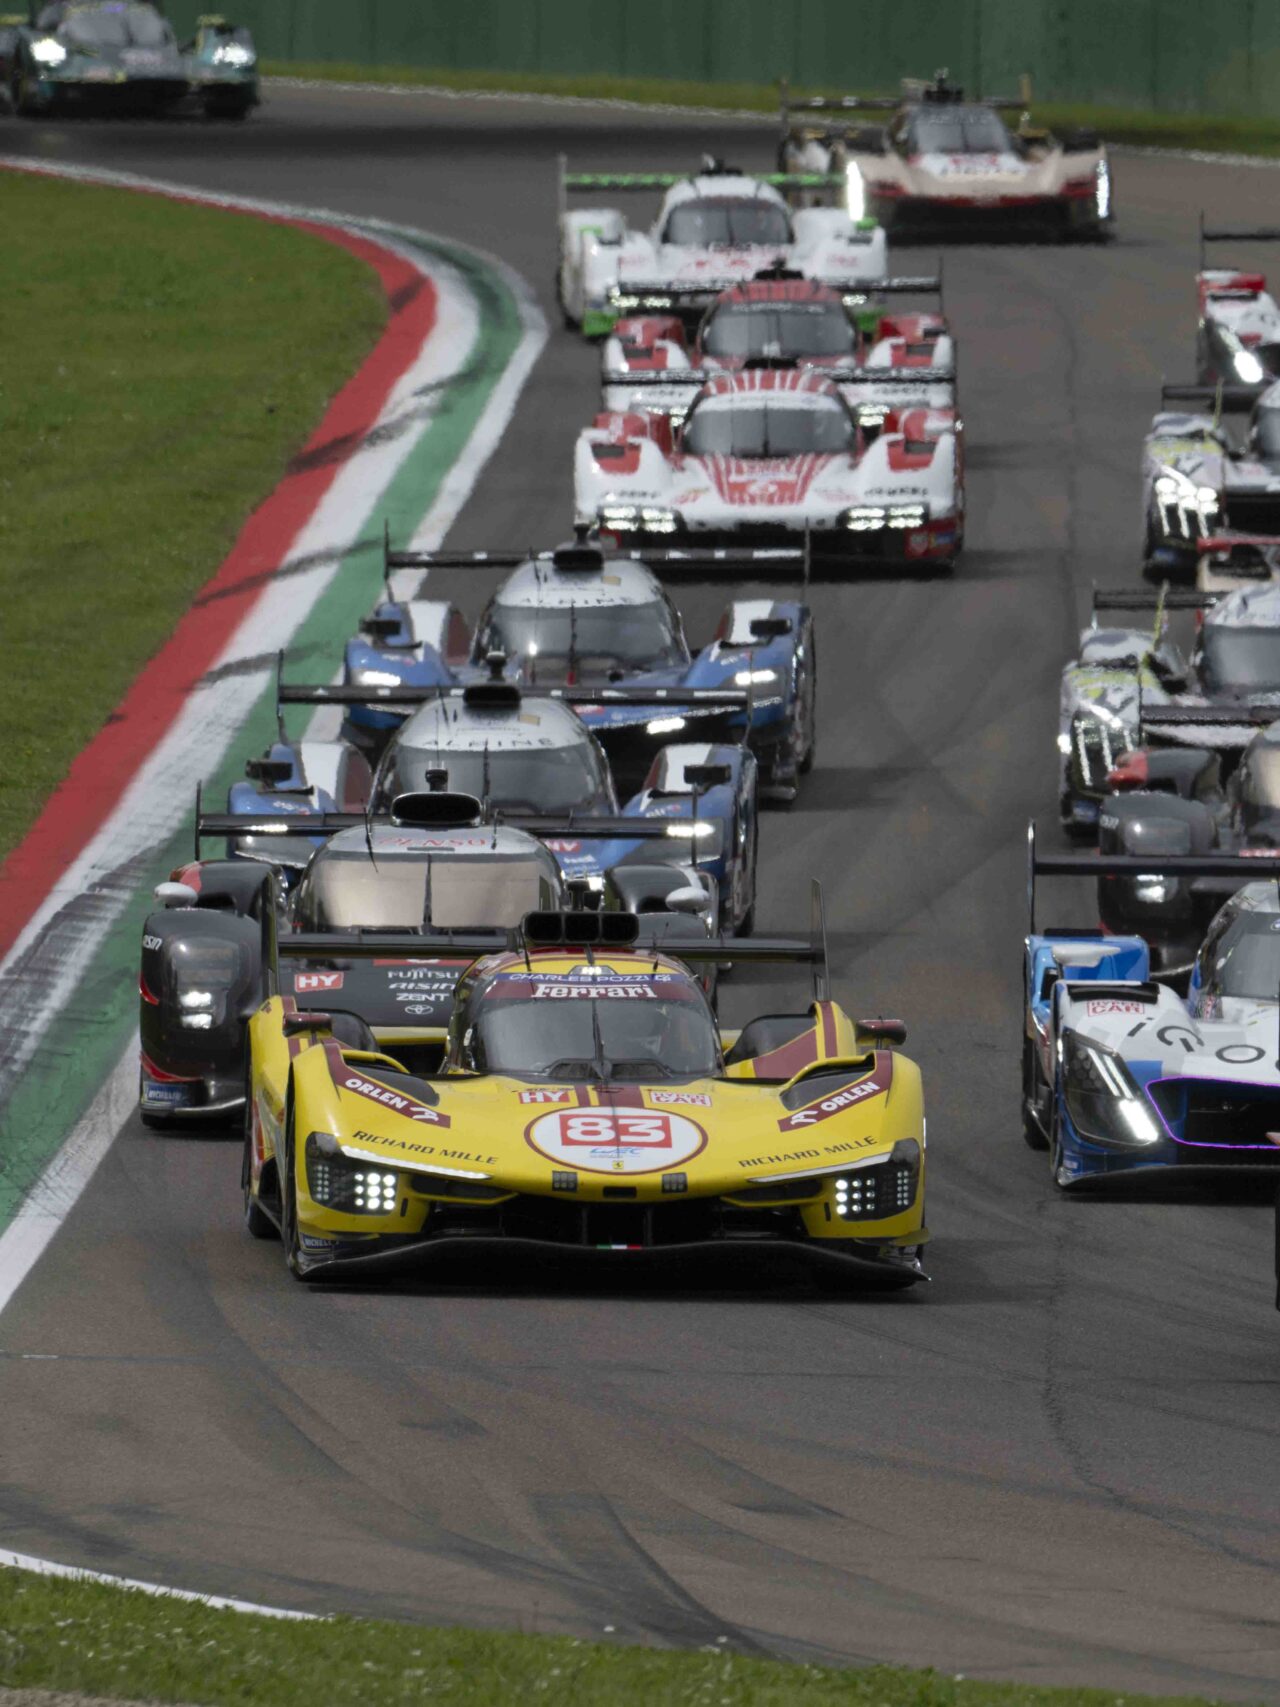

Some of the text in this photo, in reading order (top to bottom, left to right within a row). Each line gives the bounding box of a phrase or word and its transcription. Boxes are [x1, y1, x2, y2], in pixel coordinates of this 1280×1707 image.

[388, 968, 459, 980] FUJITSU
[509, 973, 592, 982] CHARLES
[596, 975, 650, 983] POZZI
[298, 975, 339, 988] HY
[396, 992, 450, 1002] ZENT
[531, 984, 658, 998] Ferrari
[1091, 1005, 1140, 1014] CAR
[345, 1079, 408, 1109] ORLEN
[520, 1090, 567, 1103] HY
[655, 1096, 706, 1105] CAR
[820, 1081, 880, 1111] ORLEN
[566, 1117, 666, 1143] 83
[352, 1130, 499, 1165] RICHARD MILLE
[738, 1135, 878, 1168] RICHARD MILLE
